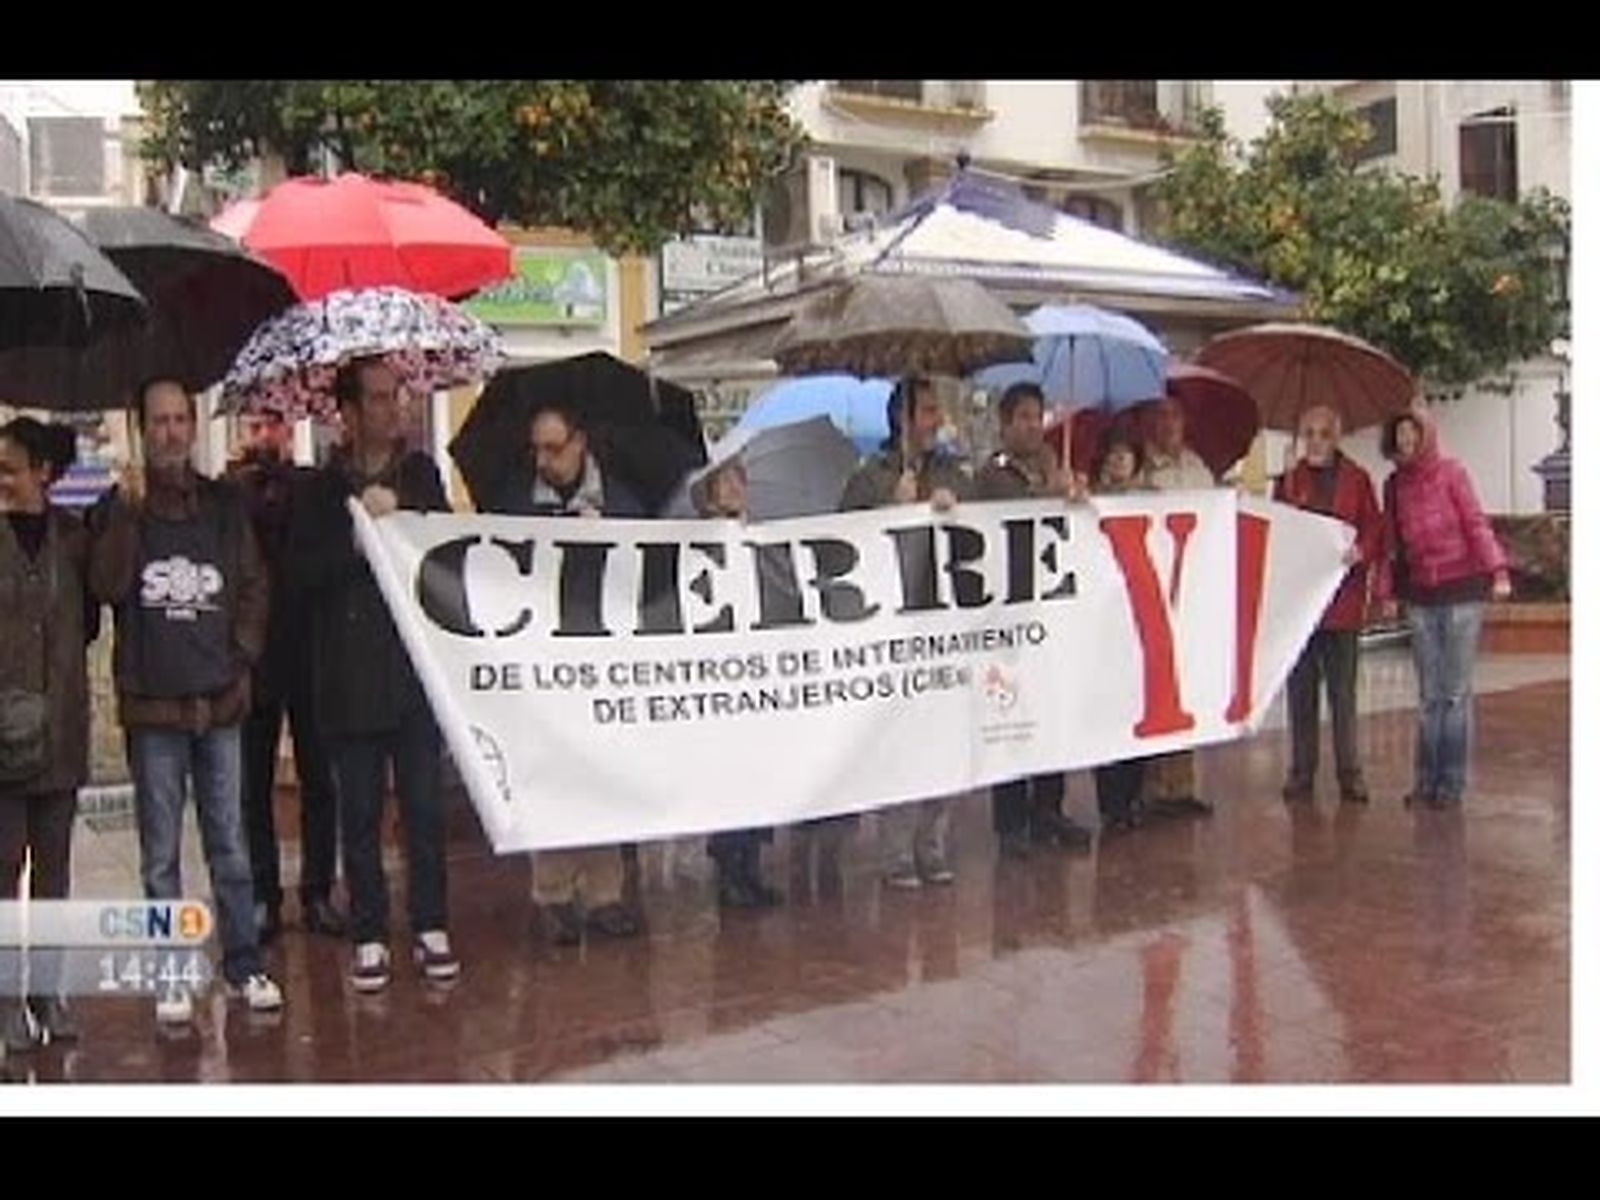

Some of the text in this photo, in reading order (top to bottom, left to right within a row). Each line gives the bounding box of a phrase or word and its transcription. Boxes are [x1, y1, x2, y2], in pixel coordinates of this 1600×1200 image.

[418, 516, 1077, 637] CIERRE
[470, 663, 522, 691] DE
[532, 662, 600, 690] LOS
[607, 653, 768, 686] CENTROS
[777, 649, 822, 677] DE
[592, 697, 637, 724] DE
[648, 672, 896, 723] EXTRANJEROS
